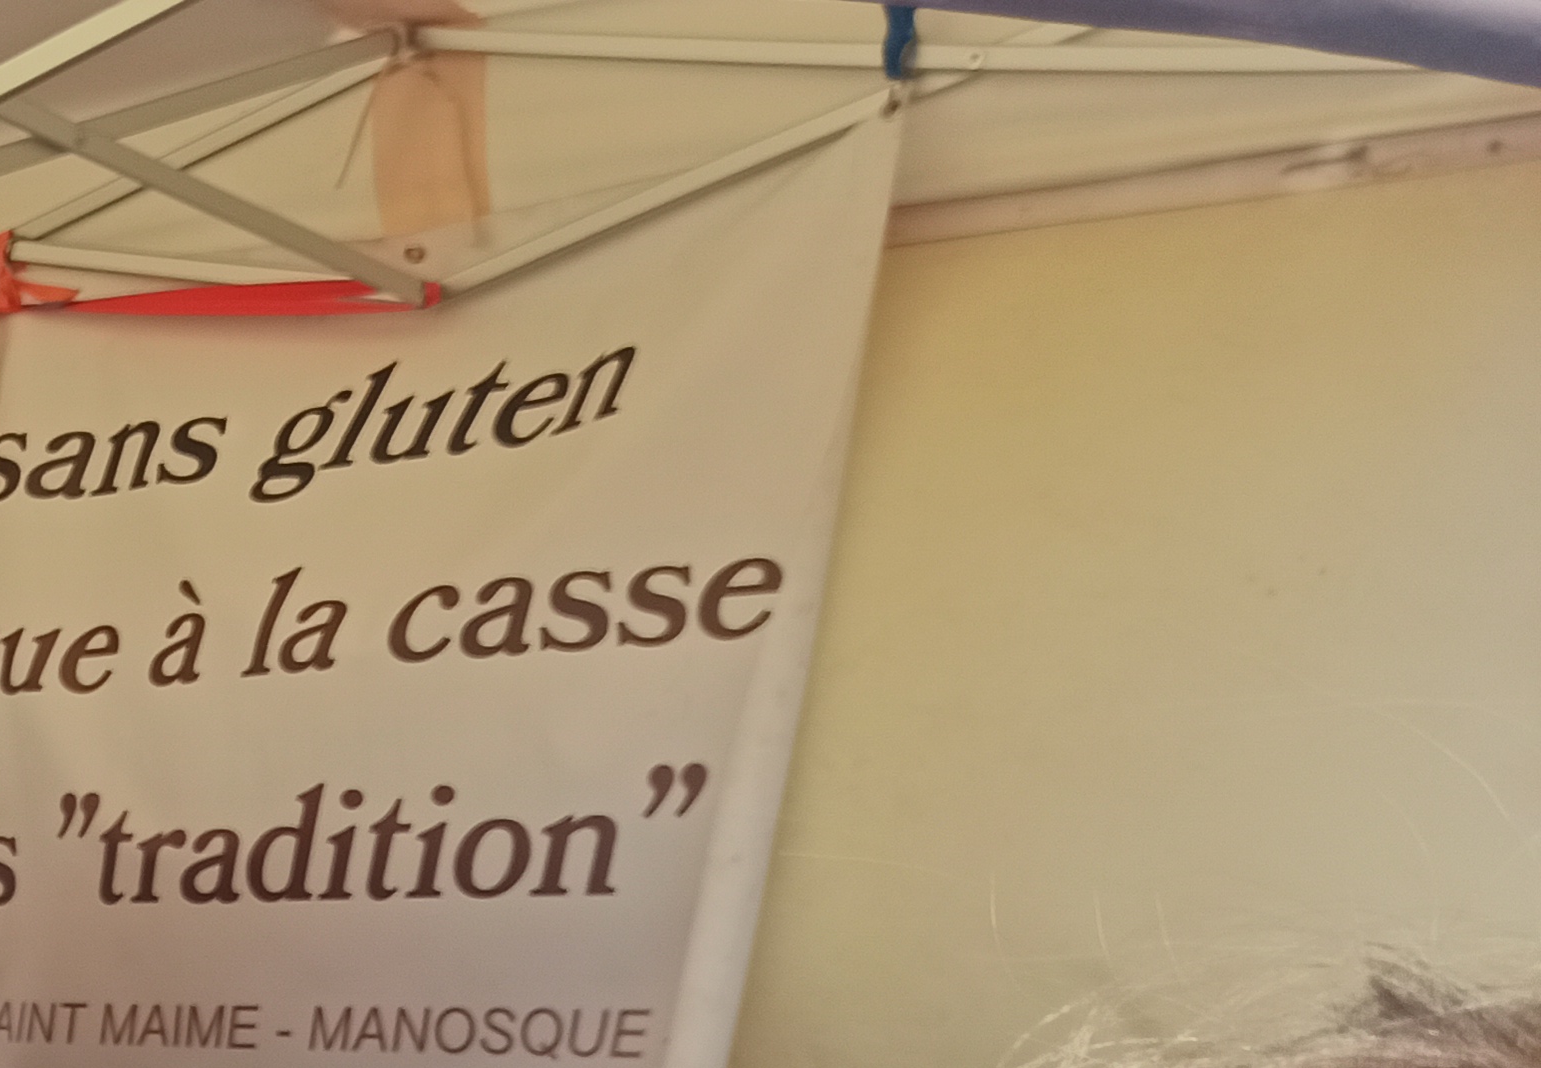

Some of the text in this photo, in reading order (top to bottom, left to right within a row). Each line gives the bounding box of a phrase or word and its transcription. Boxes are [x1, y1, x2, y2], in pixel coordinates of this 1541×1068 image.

[248, 345, 637, 503] gluten
[148, 579, 206, 687] à
[239, 565, 348, 678] la
[387, 557, 784, 664] casse
[98, 1002, 262, 1050] MAIME
[308, 1005, 654, 1059] MANOSQUE
